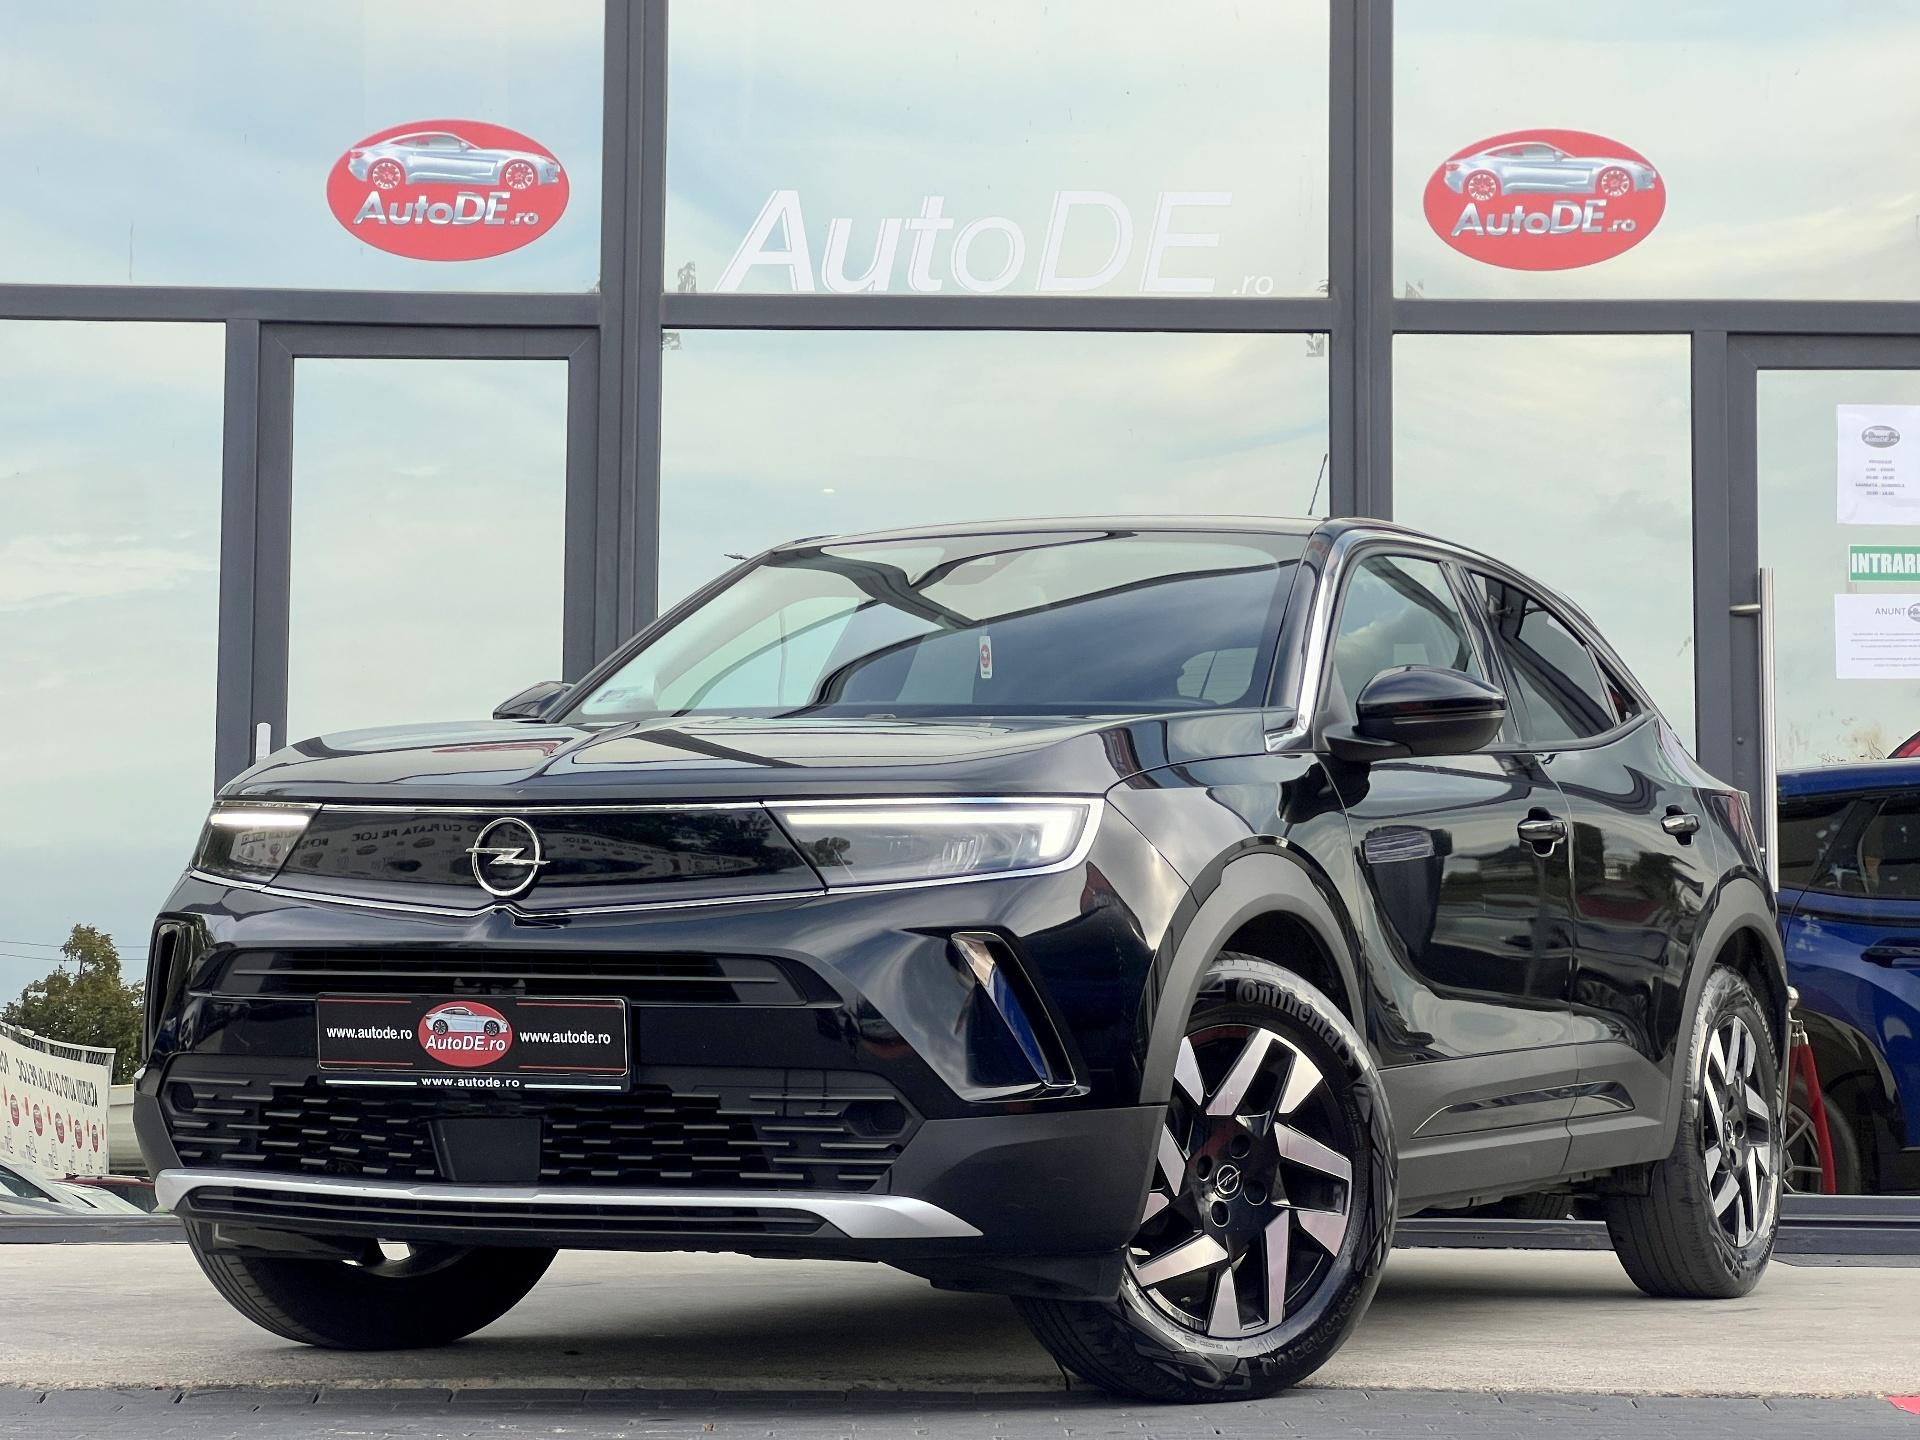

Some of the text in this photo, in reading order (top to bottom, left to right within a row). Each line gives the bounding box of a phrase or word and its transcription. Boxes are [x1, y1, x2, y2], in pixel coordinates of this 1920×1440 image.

[326, 1025, 413, 1041] www.autode.ro
[519, 1030, 611, 1046] www.autode.ro
[425, 1034, 506, 1052] AutoDE.ro
[421, 1076, 520, 1089] www.autode.ro
